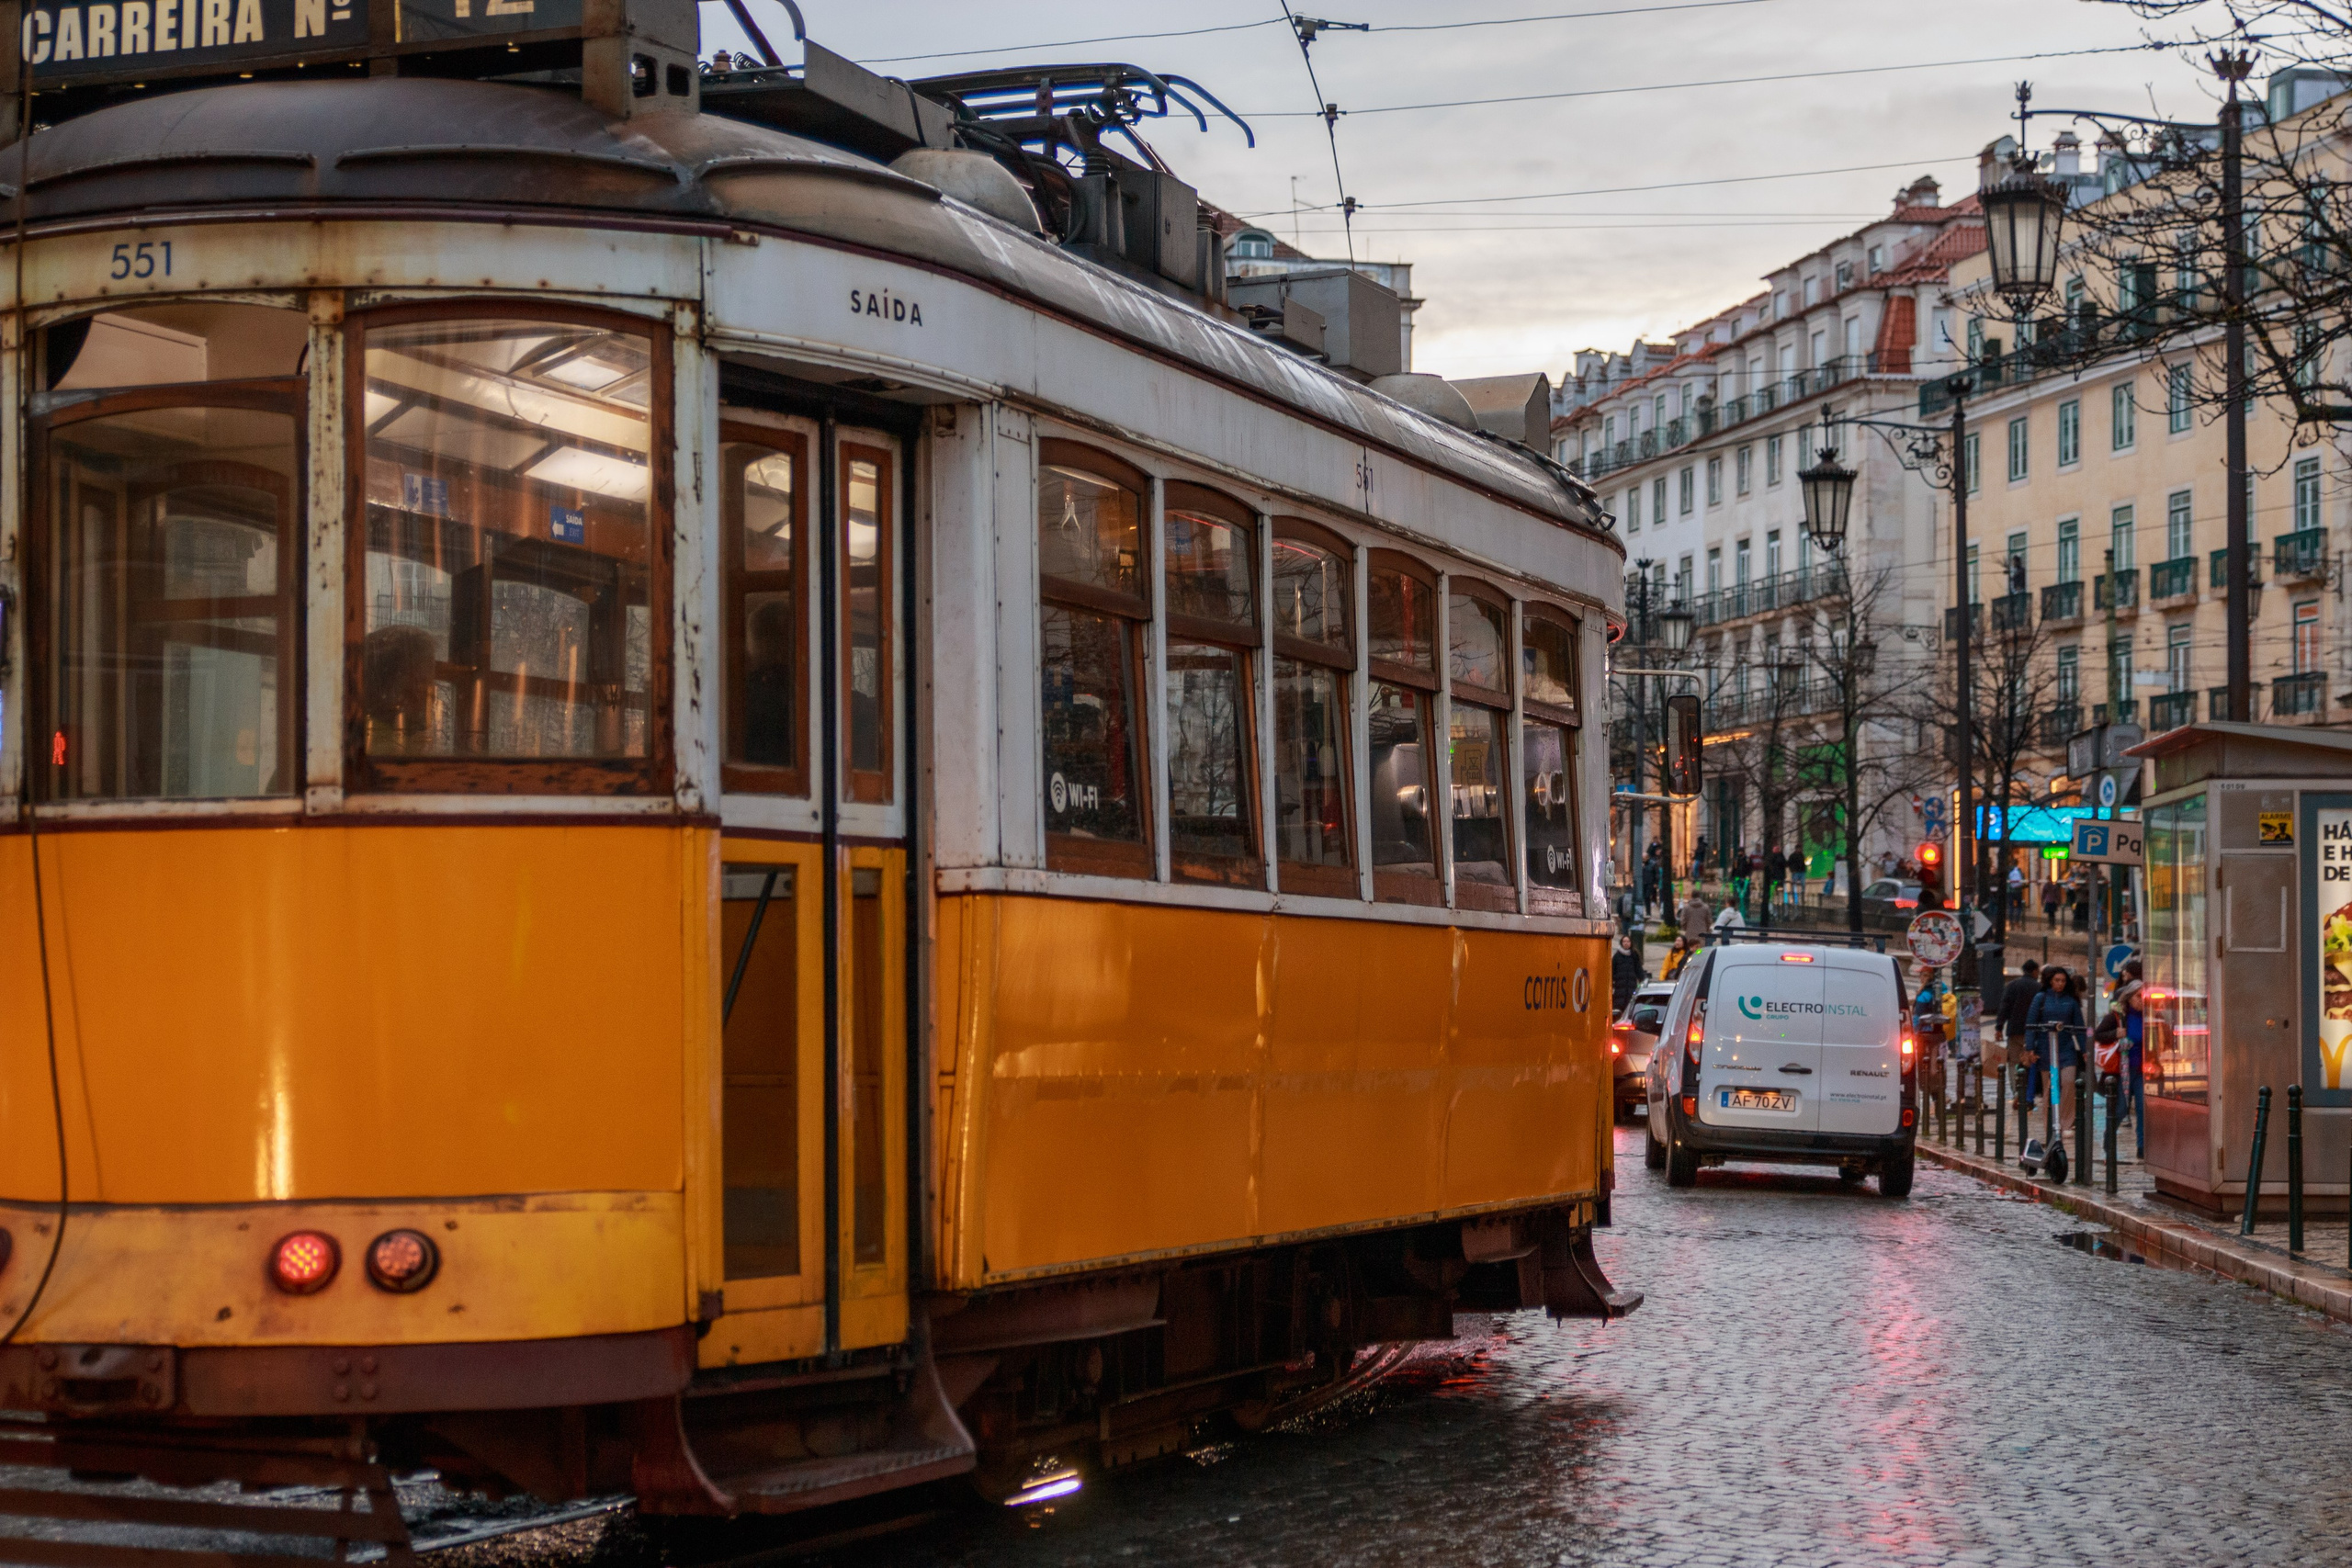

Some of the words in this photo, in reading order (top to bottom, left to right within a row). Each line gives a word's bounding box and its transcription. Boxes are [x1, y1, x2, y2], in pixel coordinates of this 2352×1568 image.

[22, 0, 265, 64] CARREIRA
[111, 241, 172, 280] 551
[851, 288, 923, 327] SAÍDA
[1356, 463, 1374, 493] 551
[565, 513, 583, 525] SAÍDA
[1069, 783, 1098, 810] WI-FI
[2324, 845, 2335, 861] E
[2324, 865, 2350, 881] DE
[1524, 962, 1566, 1010] corris
[1766, 1001, 1867, 1017] ELECTROINSTAL
[1849, 1069, 1890, 1077] RENAULT
